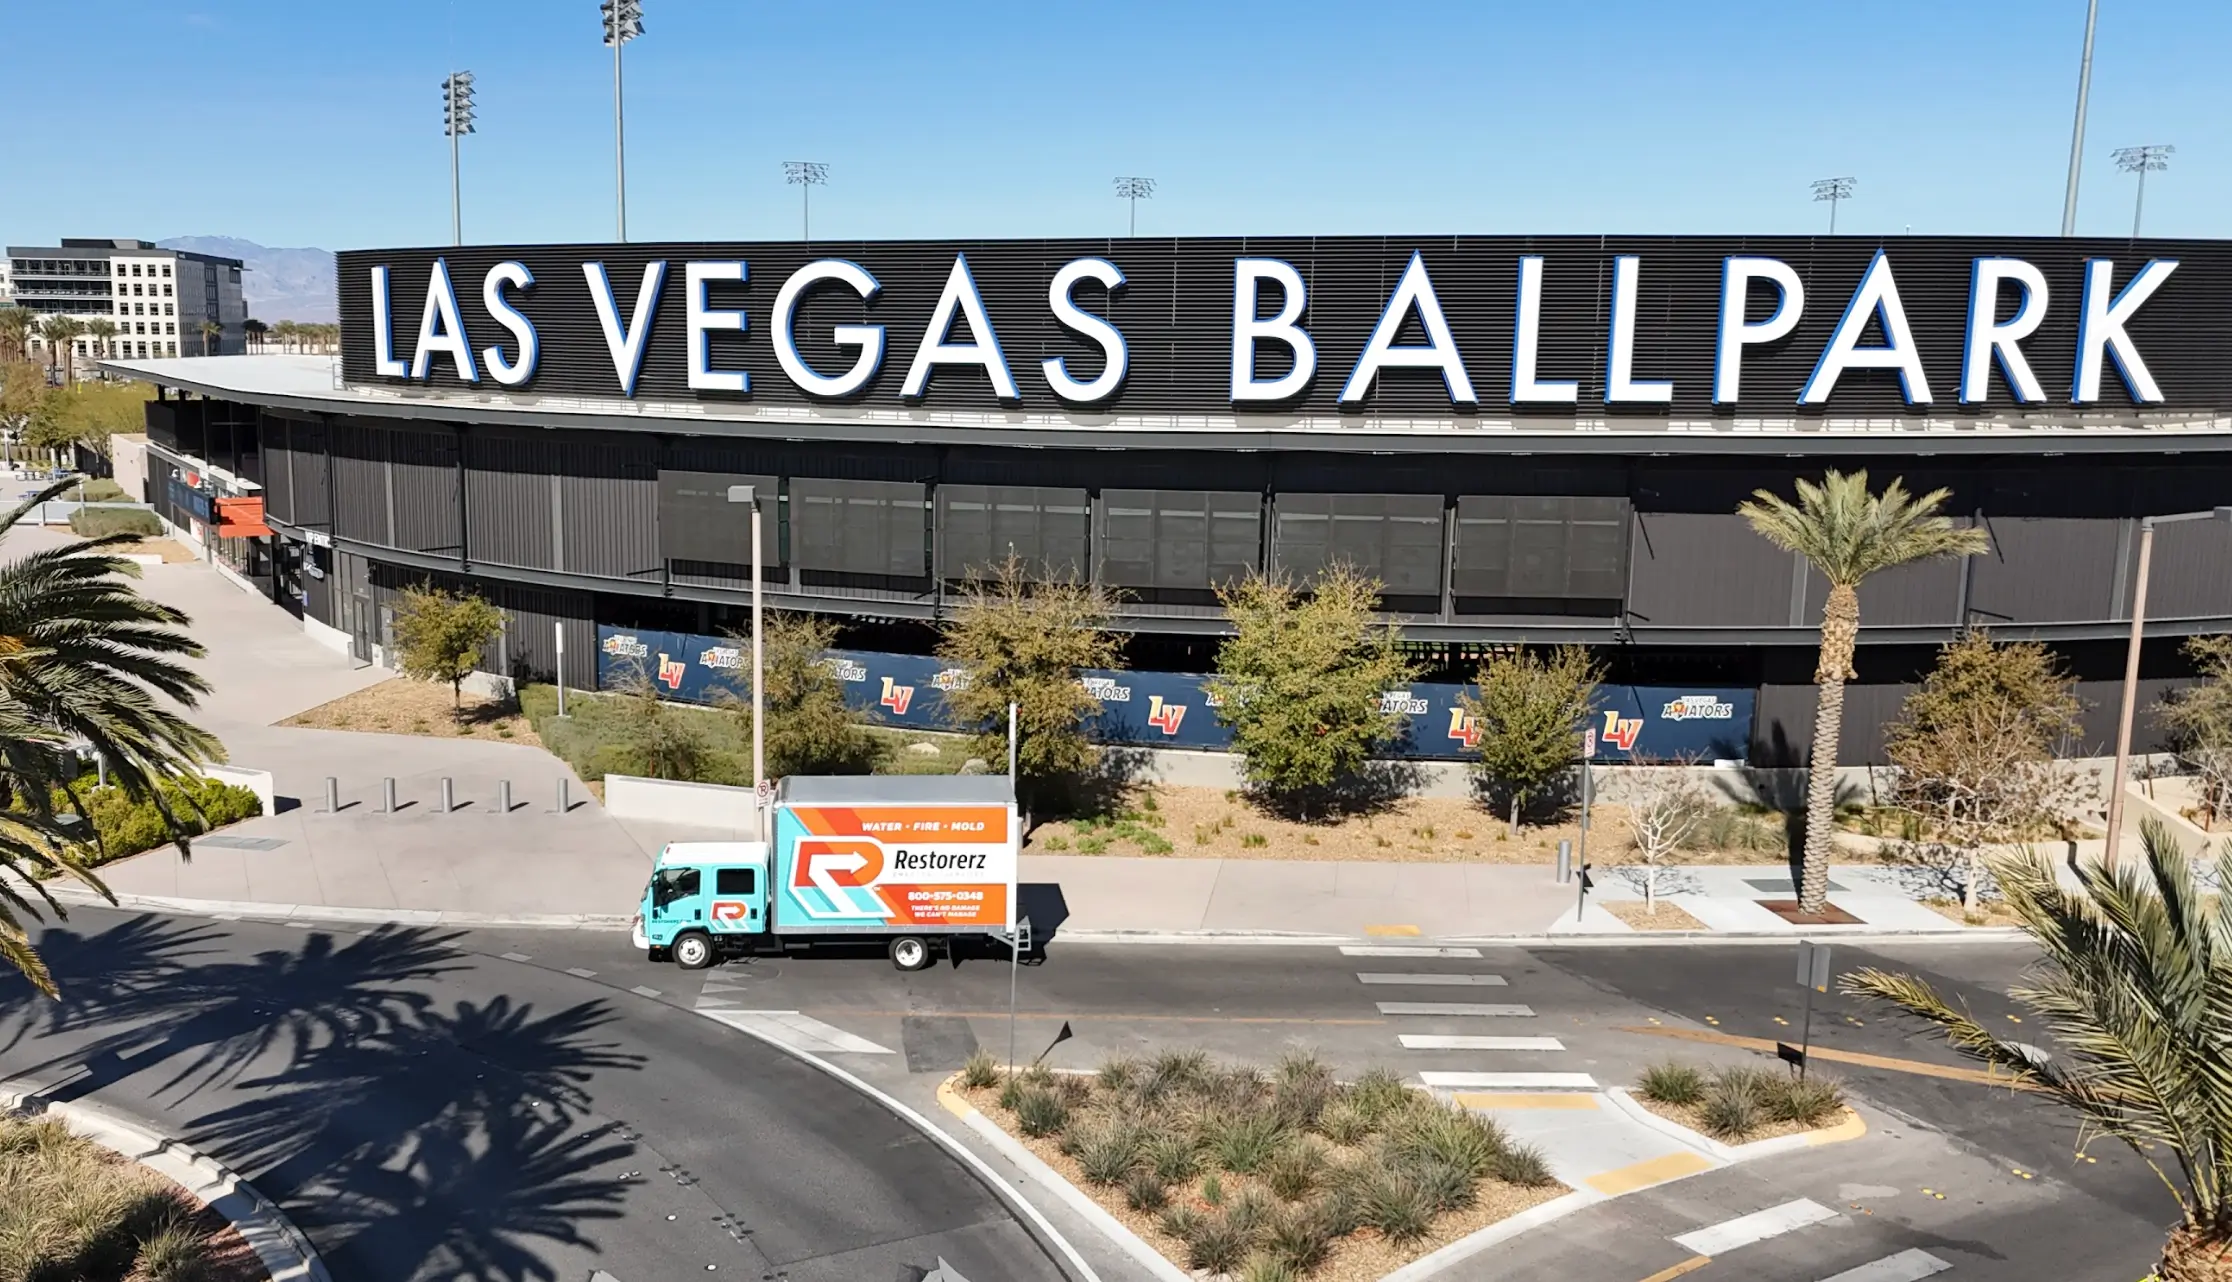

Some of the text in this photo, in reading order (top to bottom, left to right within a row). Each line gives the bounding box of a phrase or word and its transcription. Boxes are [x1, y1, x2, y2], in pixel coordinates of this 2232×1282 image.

[371, 248, 2181, 404] LAS VEGAS BALLPARK
[658, 653, 686, 690] LV
[880, 676, 914, 715] LV
[1148, 695, 1187, 735] LV
[1602, 711, 1644, 750] LV
[862, 821, 985, 831] WATER FIRE MOLD
[894, 849, 987, 870] Restorerz
